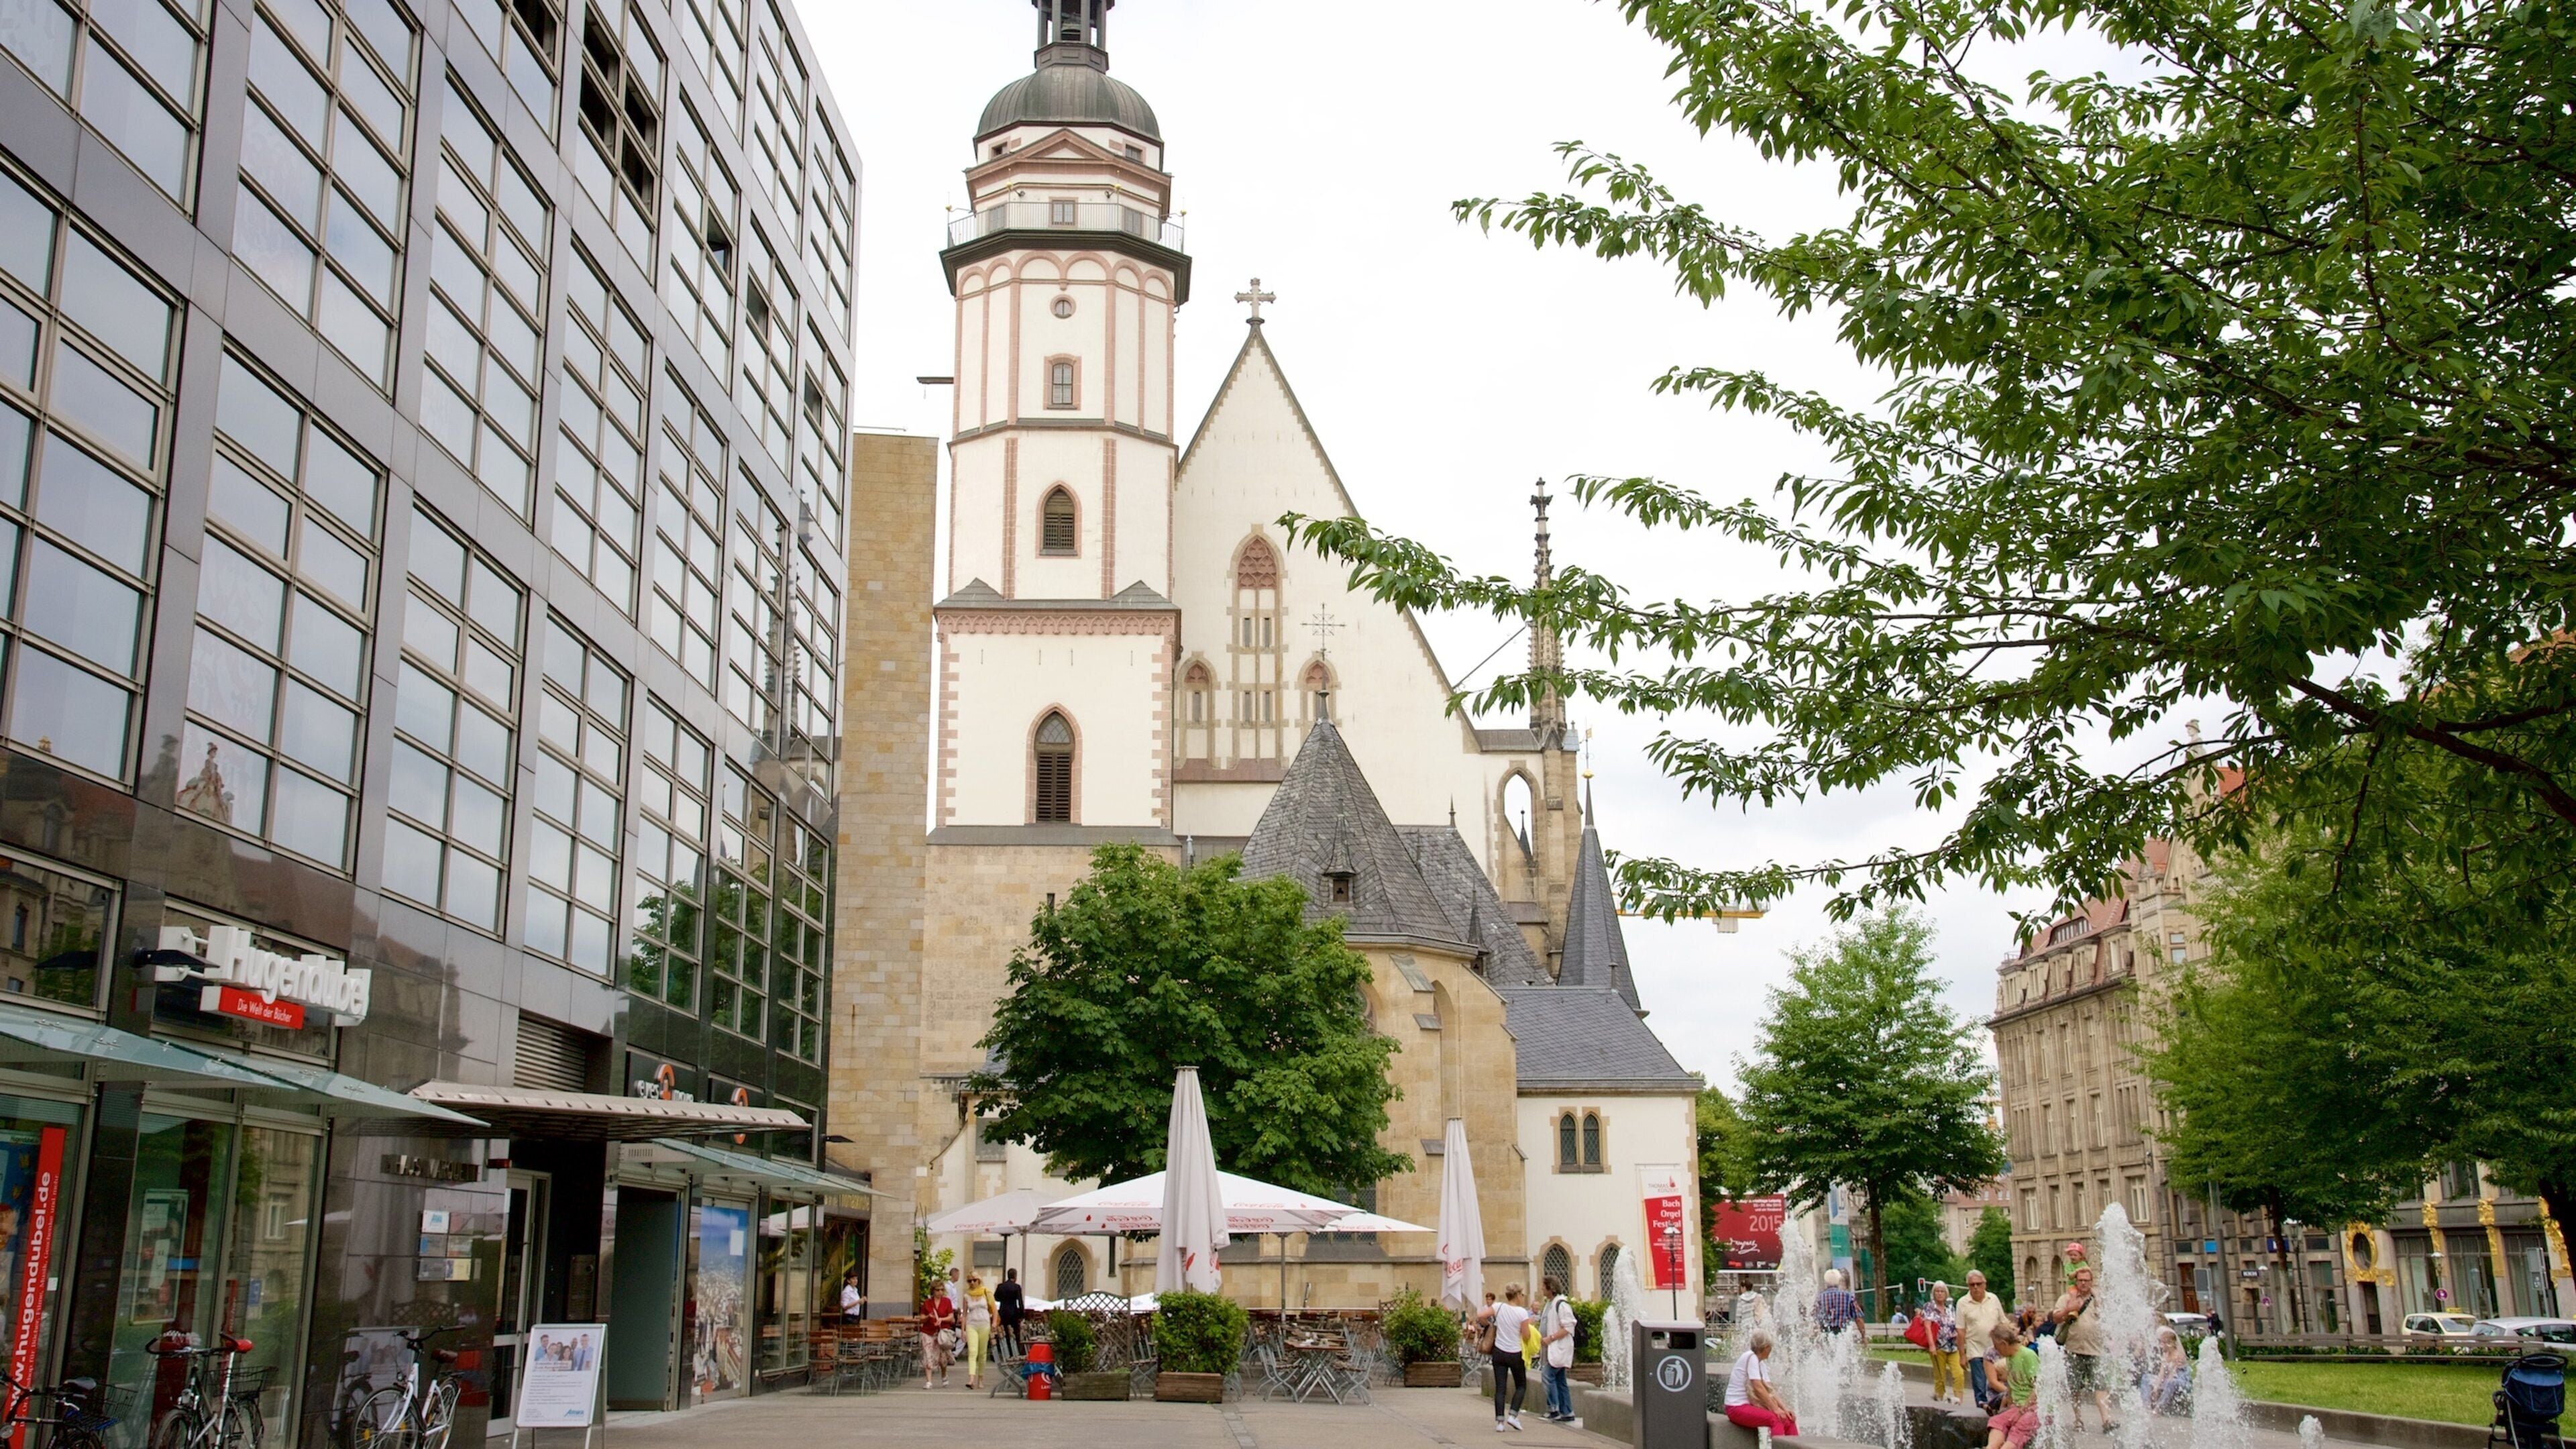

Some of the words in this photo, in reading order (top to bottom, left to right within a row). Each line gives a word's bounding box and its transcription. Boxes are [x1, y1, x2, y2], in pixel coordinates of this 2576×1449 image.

[219, 926, 372, 1017] Hugendubel
[237, 998, 248, 1013] Die
[249, 1001, 263, 1014] Welt
[263, 1006, 272, 1018] der
[274, 1007, 292, 1024] Bücher
[1662, 1199, 1680, 1208] Bach
[1660, 1210, 1681, 1220] Orgel
[1749, 1215, 1782, 1232] 2015
